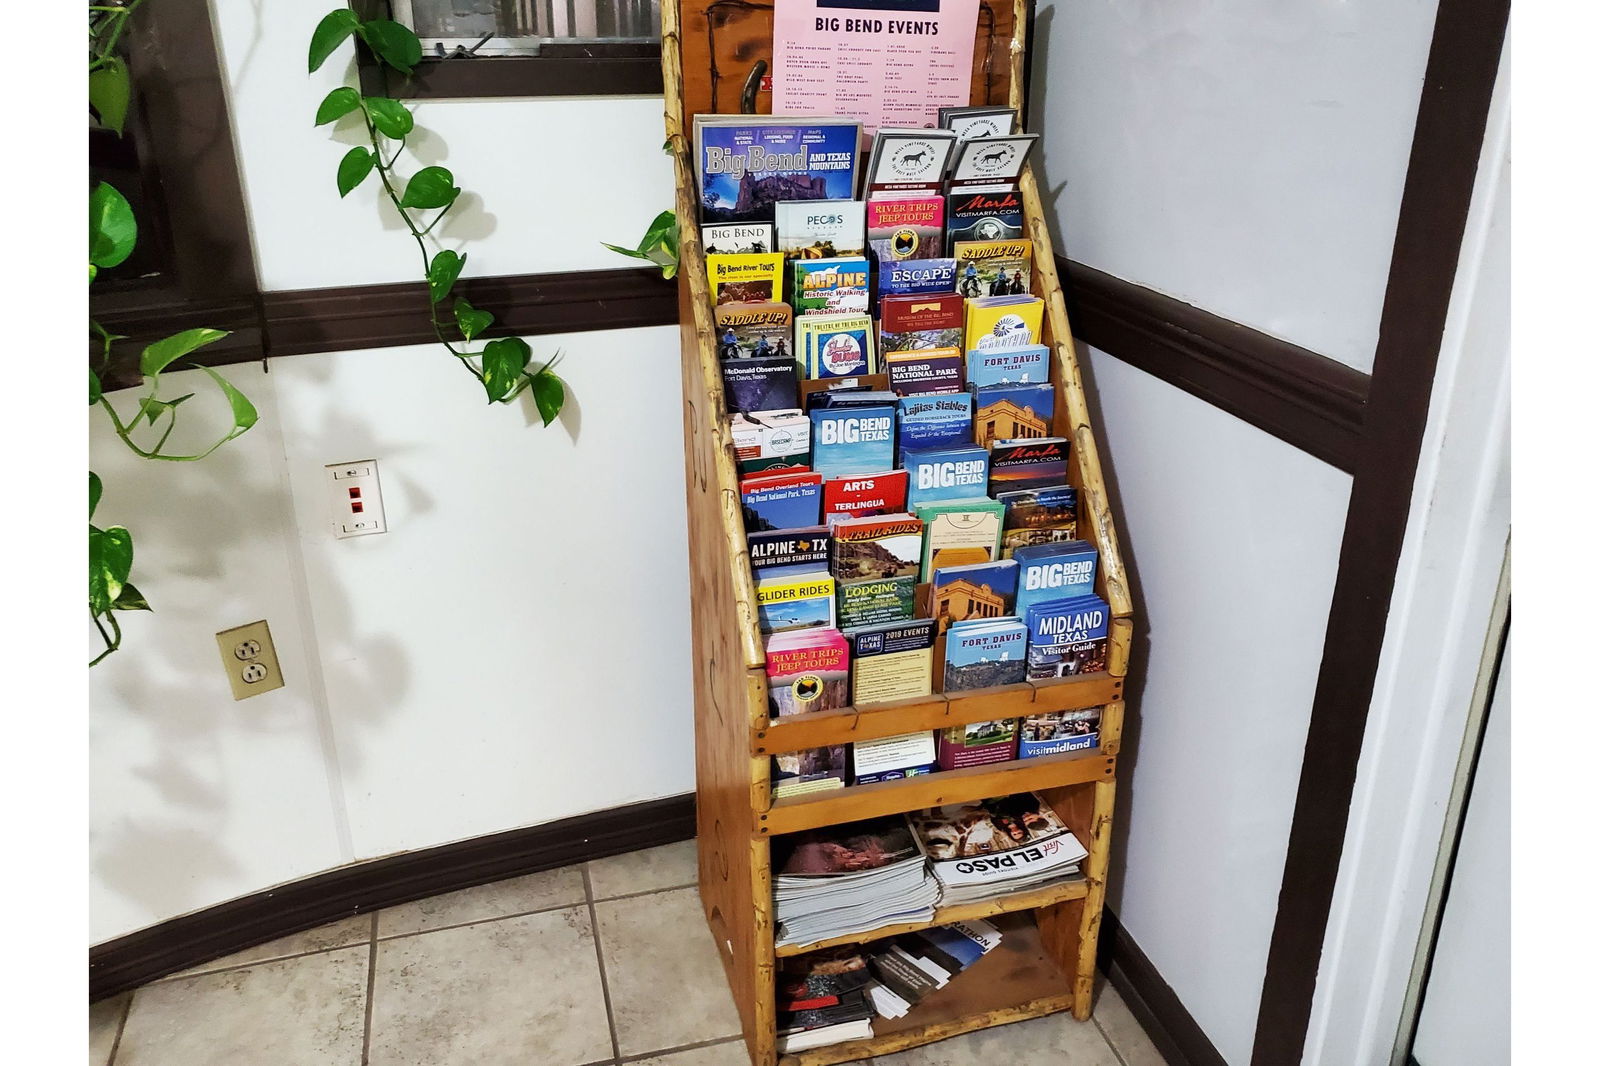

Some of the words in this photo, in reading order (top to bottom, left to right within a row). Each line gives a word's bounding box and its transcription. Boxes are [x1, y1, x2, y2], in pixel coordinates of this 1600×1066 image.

[815, 17, 840, 32] BIG
[845, 18, 882, 34] BEND
[888, 20, 939, 35] EVENTS
[705, 146, 746, 180] Big
[748, 145, 808, 173] Bend
[809, 153, 826, 162] AND
[826, 152, 851, 161] TEXAS
[808, 161, 851, 171] MOUNTAINS
[875, 204, 910, 214] RIVER
[910, 203, 938, 212] TRIPS
[956, 194, 1019, 211] Marfa
[878, 214, 900, 225] JEEP
[901, 213, 934, 222] TOURS
[955, 209, 1020, 218] VISITMARFA.COM
[711, 229, 730, 239] BIG
[734, 228, 765, 238] BEND
[962, 246, 1008, 259] SADDLE
[1008, 244, 1025, 257] UP!
[717, 263, 726, 275] Big
[727, 265, 742, 273] Bend
[891, 267, 952, 282] ESCAPE
[802, 272, 867, 290] ALPINE
[804, 289, 834, 298] Historic
[835, 288, 866, 298] Walking
[805, 306, 847, 316] Windshield
[848, 305, 864, 313] Tour
[720, 313, 765, 327] SADDLE
[766, 312, 787, 325] UP!
[984, 357, 1010, 367] FORT
[1013, 354, 1041, 364] DAVIS
[724, 367, 756, 375] McDonald
[892, 371, 935, 379] NATIONAL
[935, 368, 958, 376] PARK
[903, 403, 934, 416] Lajitas
[935, 400, 968, 412] Stables
[821, 418, 860, 445] BIG
[859, 416, 891, 431] BEND
[860, 430, 890, 442] TEXAS
[997, 444, 1061, 462] Marfa
[994, 456, 1062, 467] VISITMARFA.COM
[918, 462, 956, 490] BIG
[955, 460, 985, 475] BEND
[956, 473, 984, 487] TEXAS
[775, 483, 799, 491] Overland
[799, 481, 814, 489] Tours
[842, 480, 875, 492] ARTS
[747, 496, 755, 504] Big
[755, 494, 768, 503] Bend
[768, 491, 787, 501] National
[801, 488, 816, 497] Texas
[834, 499, 885, 511] TERLINGUA
[848, 527, 882, 541] TRAIL
[882, 522, 921, 536] RIDES
[751, 541, 796, 558] ALPINE
[812, 538, 828, 551] TX
[791, 554, 812, 562] STARTS
[812, 552, 827, 560] HERE
[1025, 563, 1063, 591] BIG
[1062, 560, 1093, 575] BEND
[1063, 573, 1091, 586] TEXAS
[757, 590, 796, 602] GLIDER
[799, 584, 830, 597] RIDES
[845, 582, 898, 598] LODGING
[1038, 610, 1103, 636] MIDLAND
[860, 635, 881, 643] ALPINE
[885, 632, 902, 640] 2019
[903, 627, 930, 637] EVENTS
[962, 637, 989, 648] FORT
[993, 632, 1023, 644] DAVIS
[1052, 630, 1088, 645] TEXAS
[982, 643, 1002, 651] TEXAS
[1042, 644, 1071, 656] Visitor
[1071, 641, 1097, 653] Guide
[772, 653, 808, 663] RIVER
[810, 648, 844, 659] TRIPS
[776, 664, 800, 674] JEEP
[803, 658, 839, 669] TOURS
[1027, 738, 1091, 756] visitmidland
[1013, 847, 1044, 863] EL
[1042, 840, 1064, 857] Visit
[956, 855, 1017, 874] PASO
